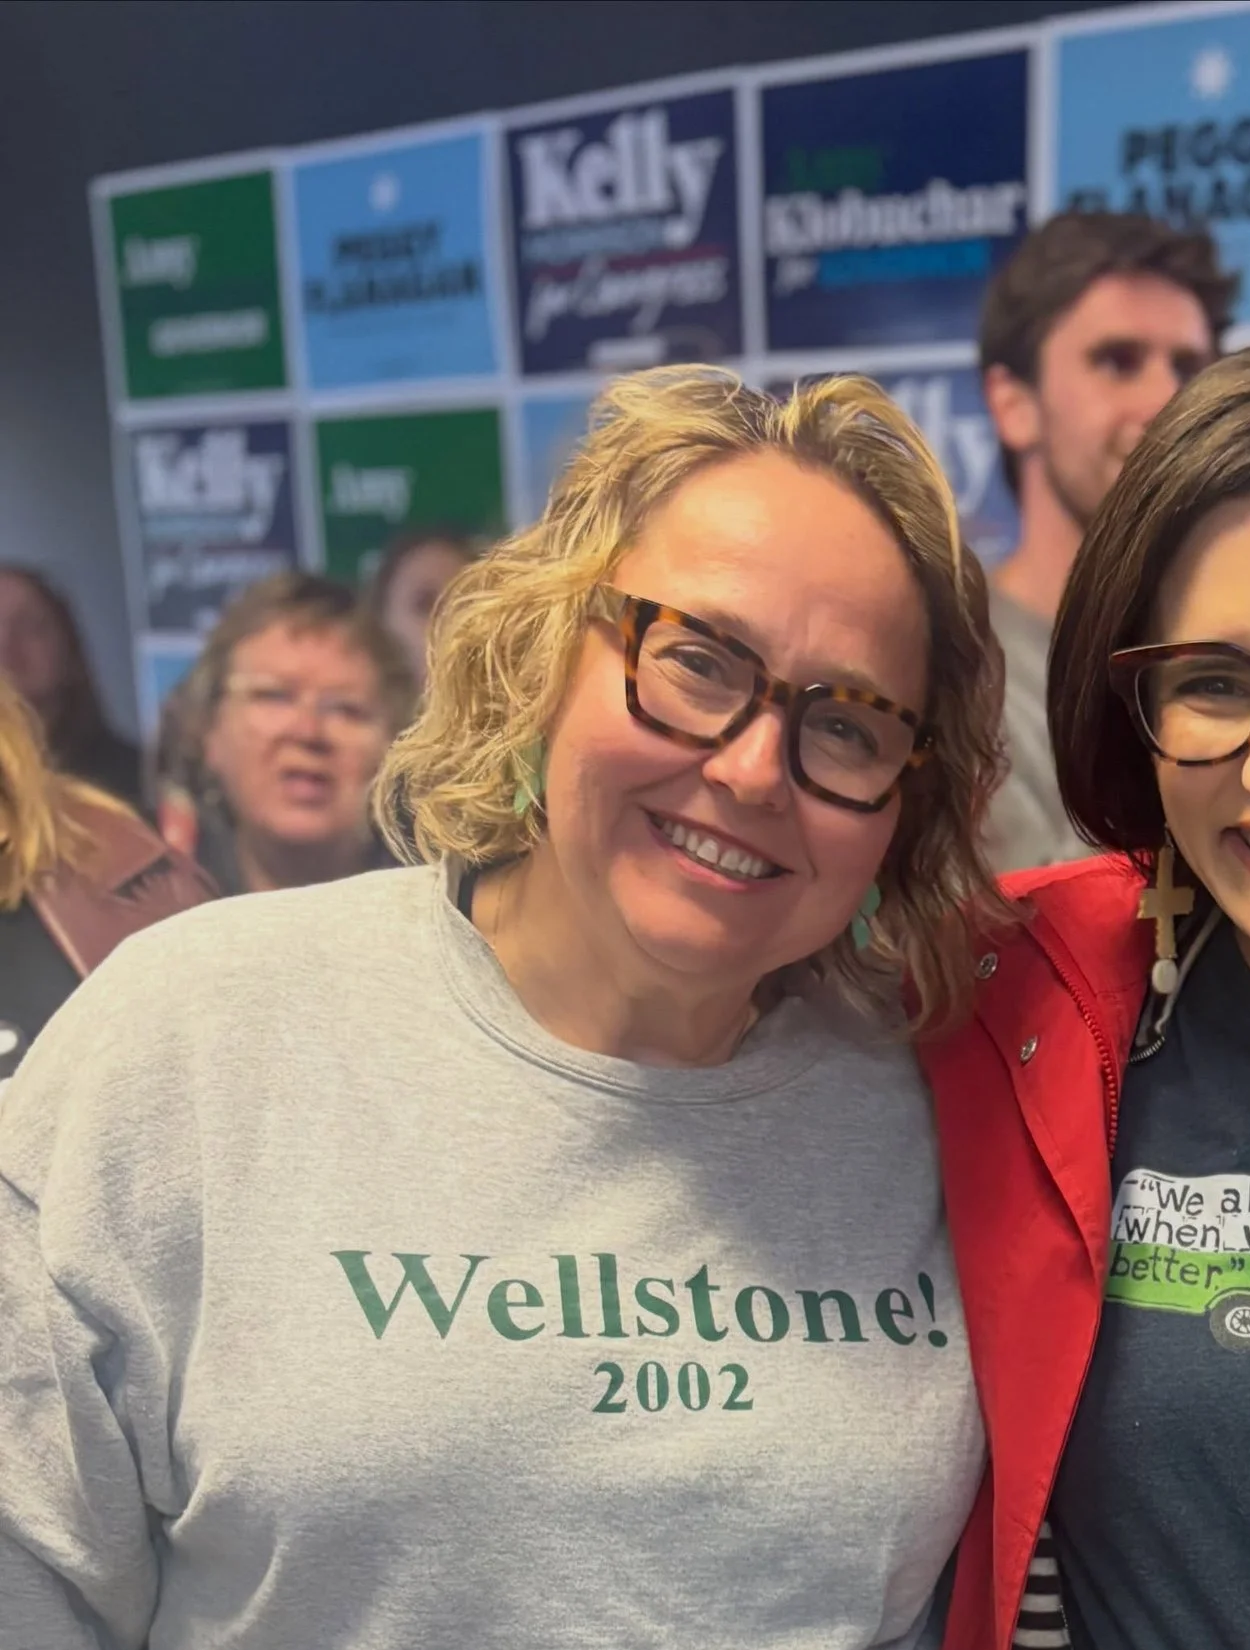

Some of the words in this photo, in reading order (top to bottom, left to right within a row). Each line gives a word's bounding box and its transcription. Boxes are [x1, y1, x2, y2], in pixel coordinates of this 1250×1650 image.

[519, 108, 721, 249] Kelly
[891, 376, 1000, 519] lly
[1124, 1211, 1220, 1248] when
[330, 1250, 948, 1348] Wellstone!
[592, 1361, 754, 1413] 2002
